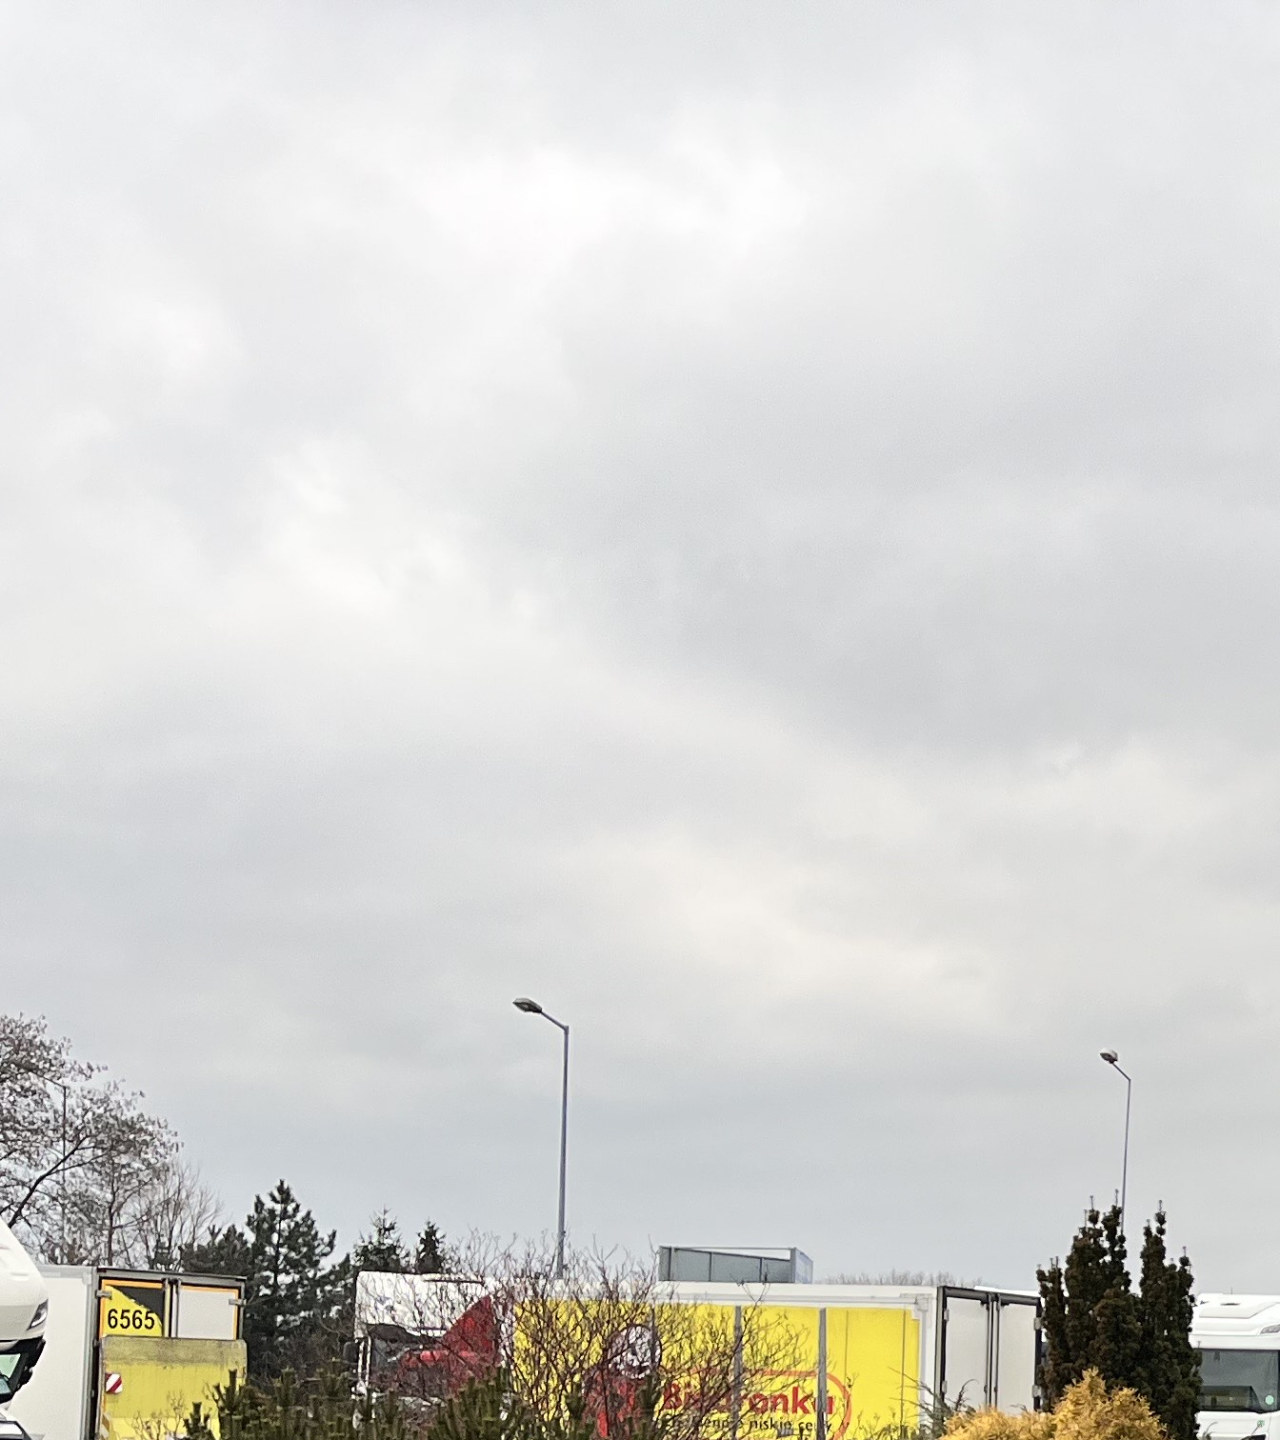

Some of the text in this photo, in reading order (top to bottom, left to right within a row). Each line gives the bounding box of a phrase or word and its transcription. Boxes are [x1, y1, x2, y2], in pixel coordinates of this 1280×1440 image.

[107, 1308, 155, 1329] 6565
[663, 1383, 834, 1415] Bionk
[798, 1421, 832, 1433] cey
